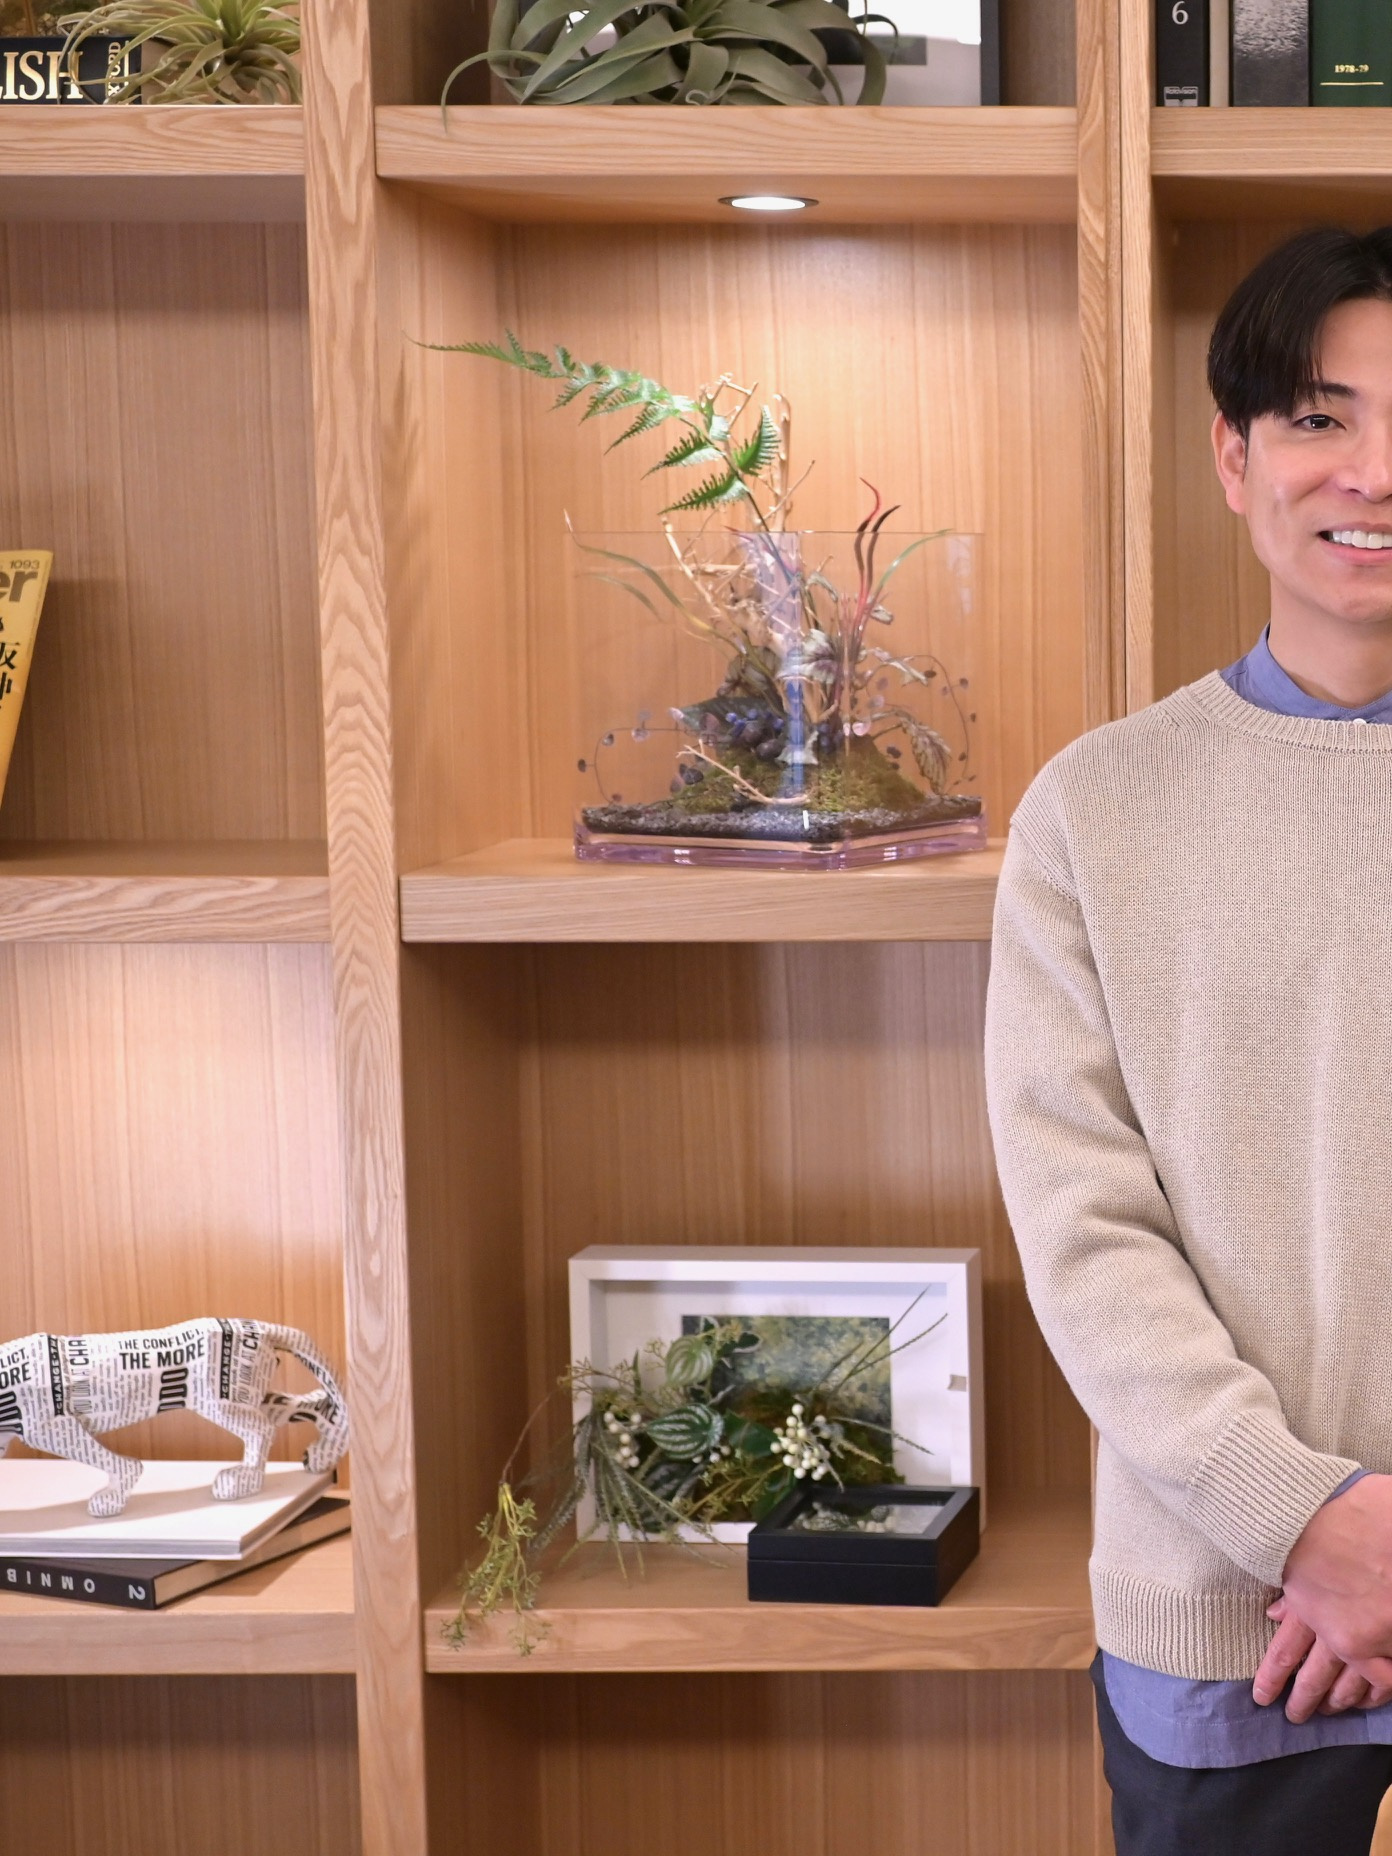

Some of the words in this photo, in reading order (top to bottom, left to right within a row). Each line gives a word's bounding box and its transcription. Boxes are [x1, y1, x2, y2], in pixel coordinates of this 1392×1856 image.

[1171, 0, 1189, 25] 6
[0, 51, 83, 100] ISH
[9, 559, 40, 570] 1093
[119, 1352, 151, 1370] THE
[157, 1336, 205, 1368] MORE
